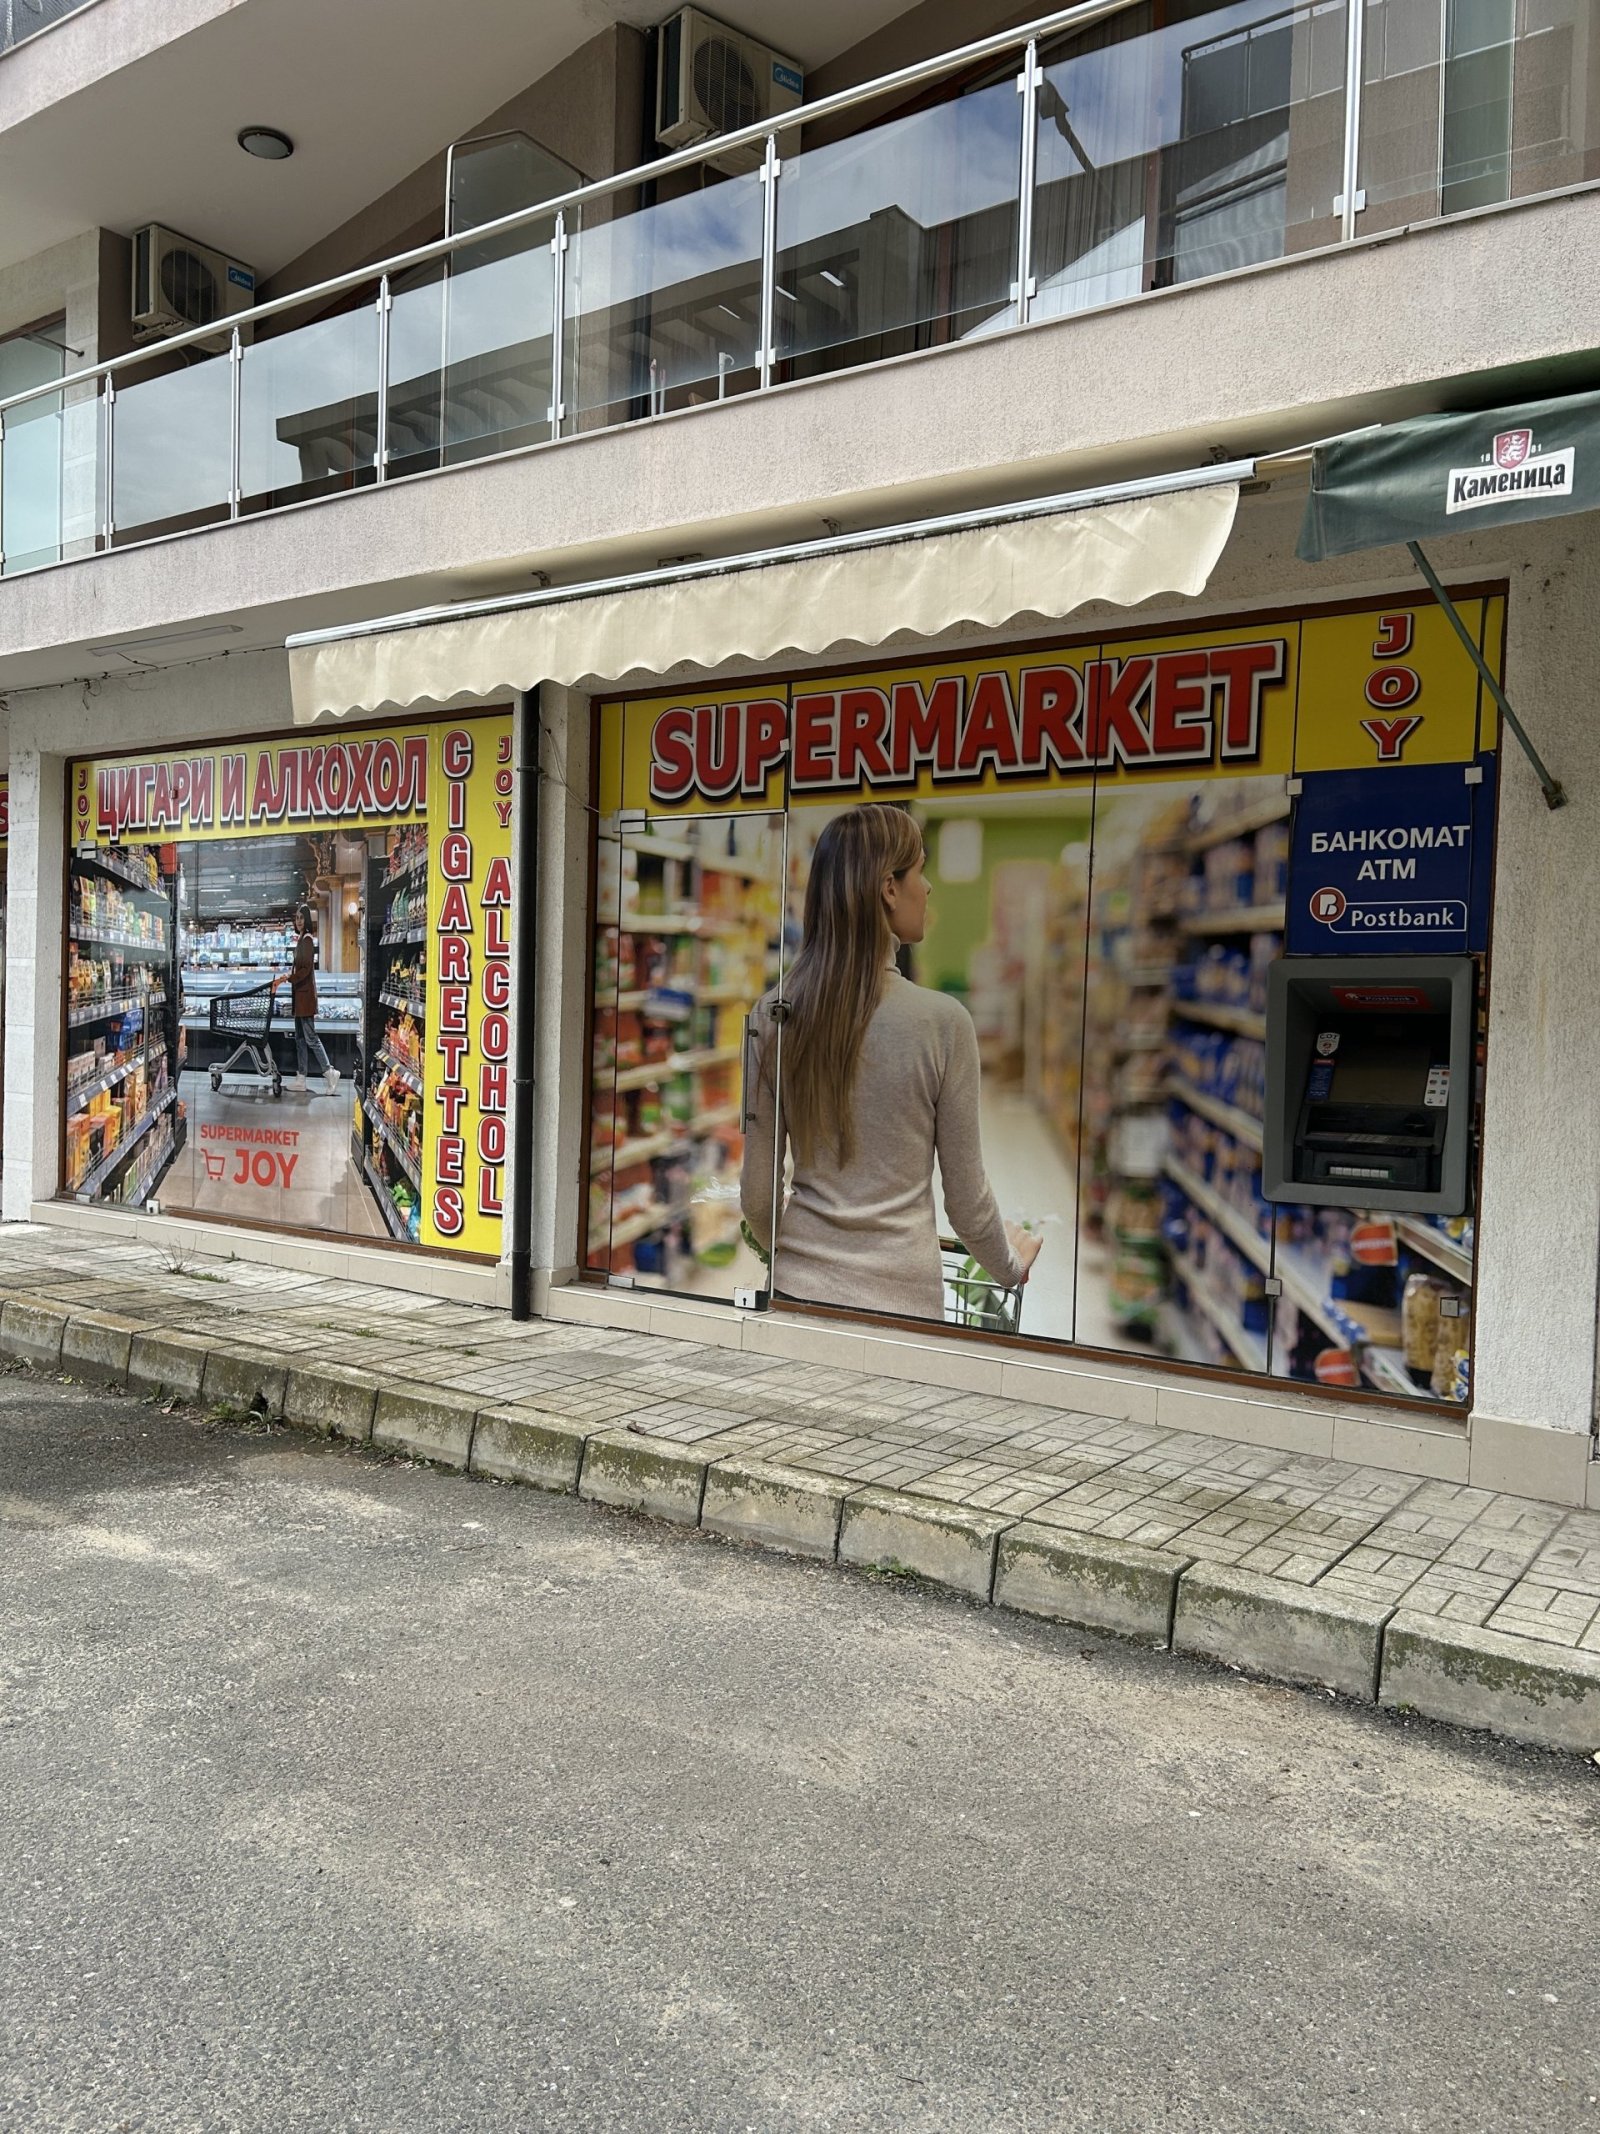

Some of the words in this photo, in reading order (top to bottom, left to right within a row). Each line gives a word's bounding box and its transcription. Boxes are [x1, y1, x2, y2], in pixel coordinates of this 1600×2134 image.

[1453, 463, 1566, 503] Каменица
[649, 639, 1287, 803] SUPERMARKET
[1362, 613, 1424, 761] JOY
[76, 767, 90, 839] JOY
[97, 758, 215, 842] ЦИГАРИ
[220, 752, 246, 823] И
[250, 735, 429, 820] АЛКОХОЛ
[493, 735, 513, 828] JOY
[1311, 825, 1471, 853] БАНКОМАТ
[1356, 858, 1416, 881] ATM
[1351, 907, 1454, 927] Postbank
[433, 730, 472, 1237] CIGARETTES
[478, 856, 512, 1216] ALCOHOL
[201, 1124, 299, 1146] SUPERMARKET
[233, 1148, 299, 1189] JOY
